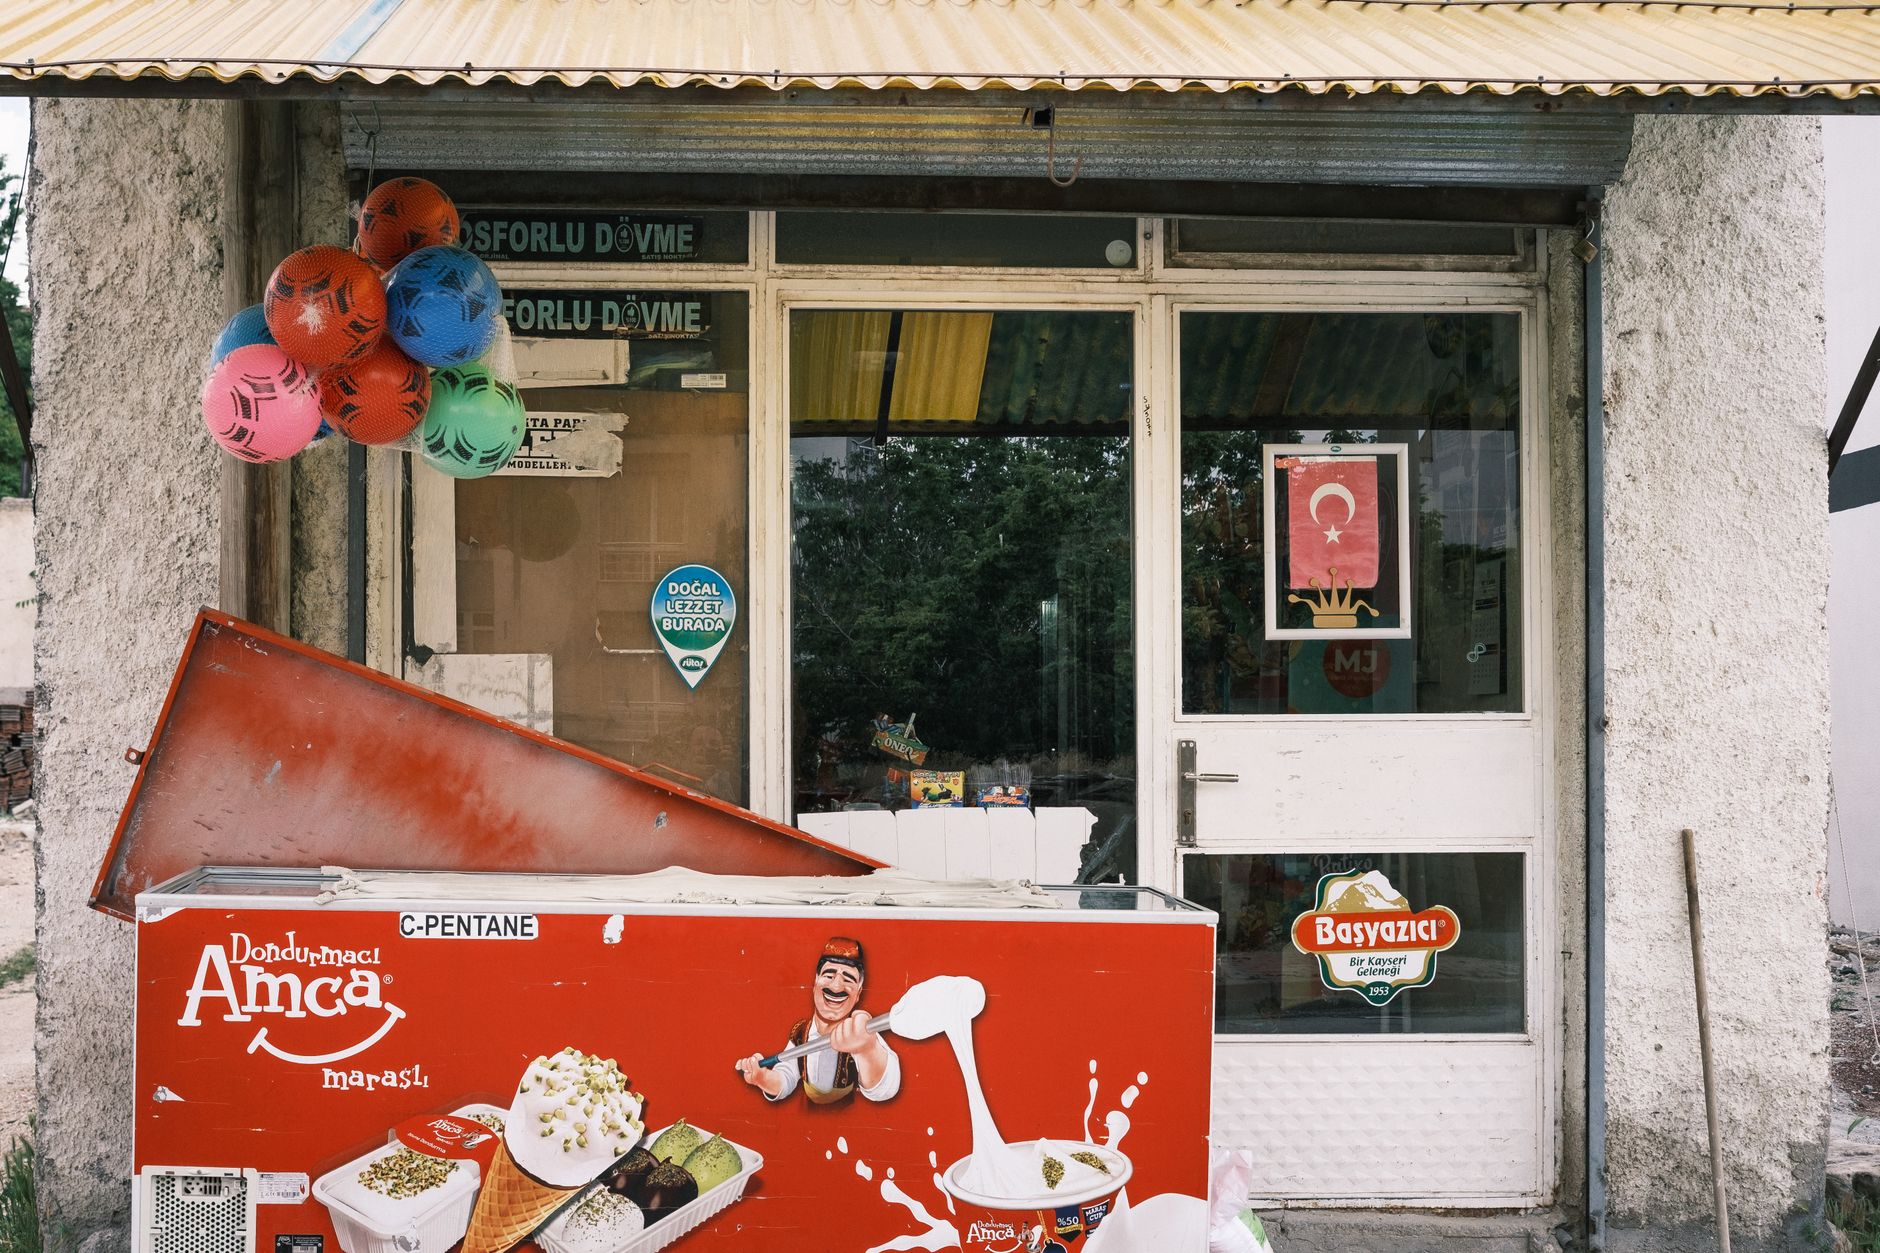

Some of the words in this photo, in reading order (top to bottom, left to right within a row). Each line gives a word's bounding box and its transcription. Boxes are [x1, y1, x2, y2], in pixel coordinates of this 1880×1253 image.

[595, 216, 694, 253] DÖVME
[602, 295, 701, 332] DÖVME
[668, 580, 720, 596] DOĞAL
[666, 600, 722, 614] LEZZET
[662, 618, 725, 631] BURADA
[1334, 649, 1378, 673] MJ
[400, 914, 534, 937] C-PENTANE
[1315, 917, 1437, 947] Başyazıcı
[230, 931, 381, 967] Dondurmacı
[1350, 956, 1365, 967] Bir
[1367, 955, 1407, 967] Kayseri
[1357, 966, 1401, 977] Geleneği
[1368, 986, 1390, 996] 1953
[322, 1064, 429, 1091] maraşlı
[1057, 1216, 1080, 1226] %50
[966, 1223, 1015, 1243] Amca
